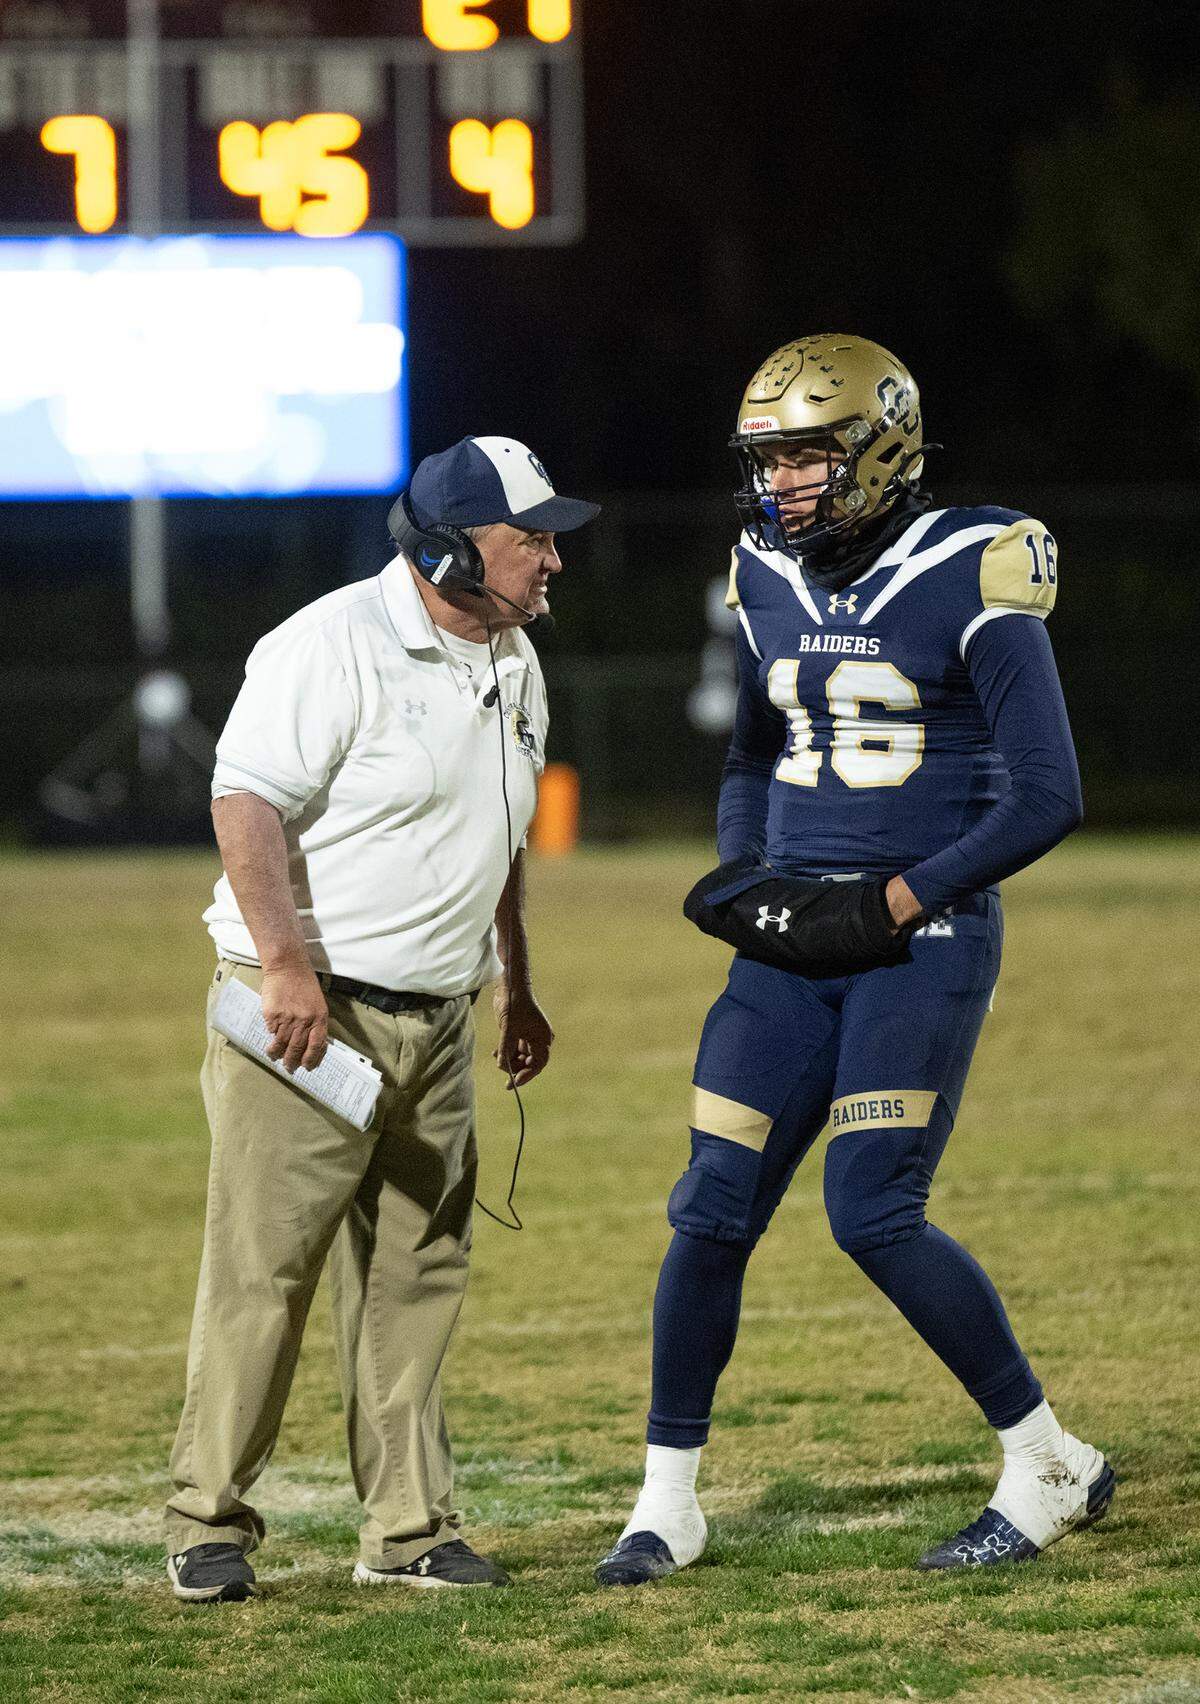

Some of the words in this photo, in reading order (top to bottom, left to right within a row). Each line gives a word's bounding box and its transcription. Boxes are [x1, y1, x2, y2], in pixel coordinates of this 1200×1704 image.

[41, 115, 118, 234] 7
[219, 113, 370, 237] 45
[450, 119, 535, 230] 4
[1025, 533, 1057, 585] 16
[799, 634, 881, 656] RAIDERS
[767, 659, 925, 788] 16
[832, 1099, 904, 1127] RAIDERS
